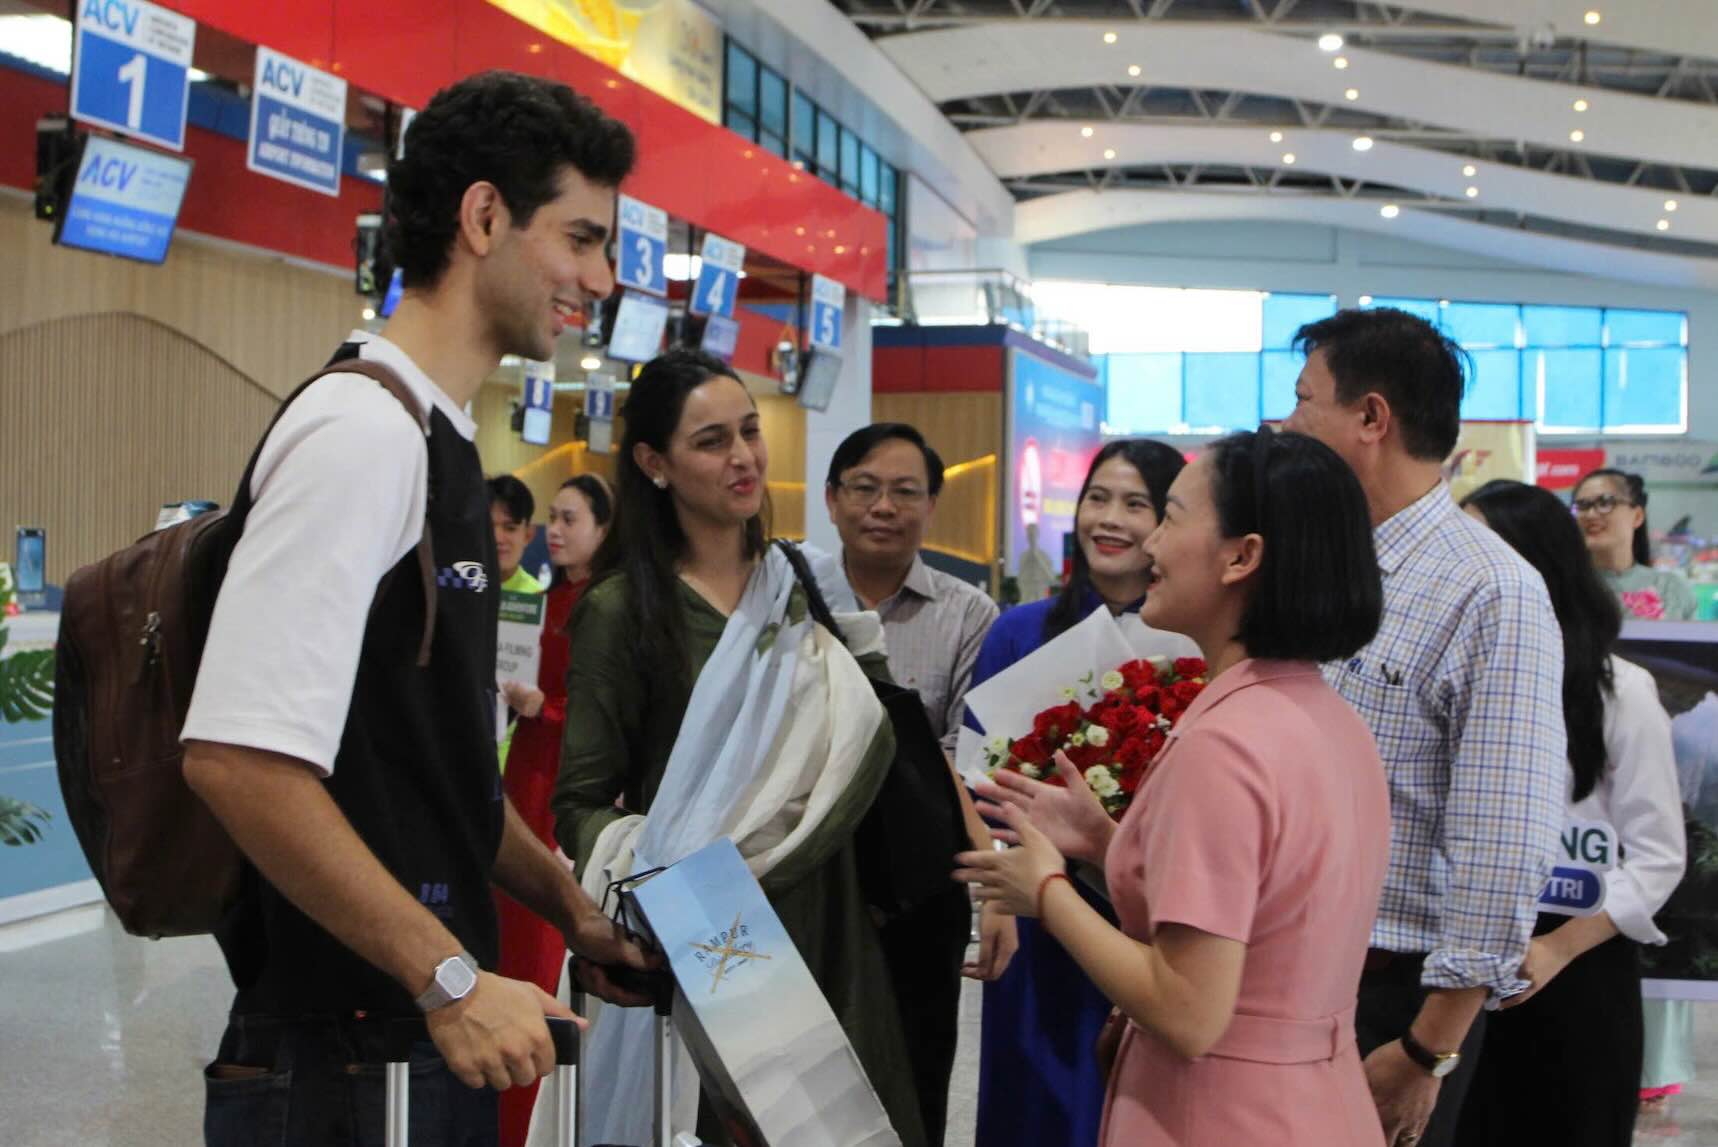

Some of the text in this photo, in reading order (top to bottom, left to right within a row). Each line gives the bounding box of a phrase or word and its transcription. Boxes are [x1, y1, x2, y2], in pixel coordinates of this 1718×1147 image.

[83, 0, 140, 35] ACV
[118, 53, 148, 129] 1
[261, 57, 305, 97] ACV
[80, 152, 139, 191] ACV
[635, 236, 654, 288] 3
[706, 271, 727, 313] 4
[820, 304, 834, 346] 5
